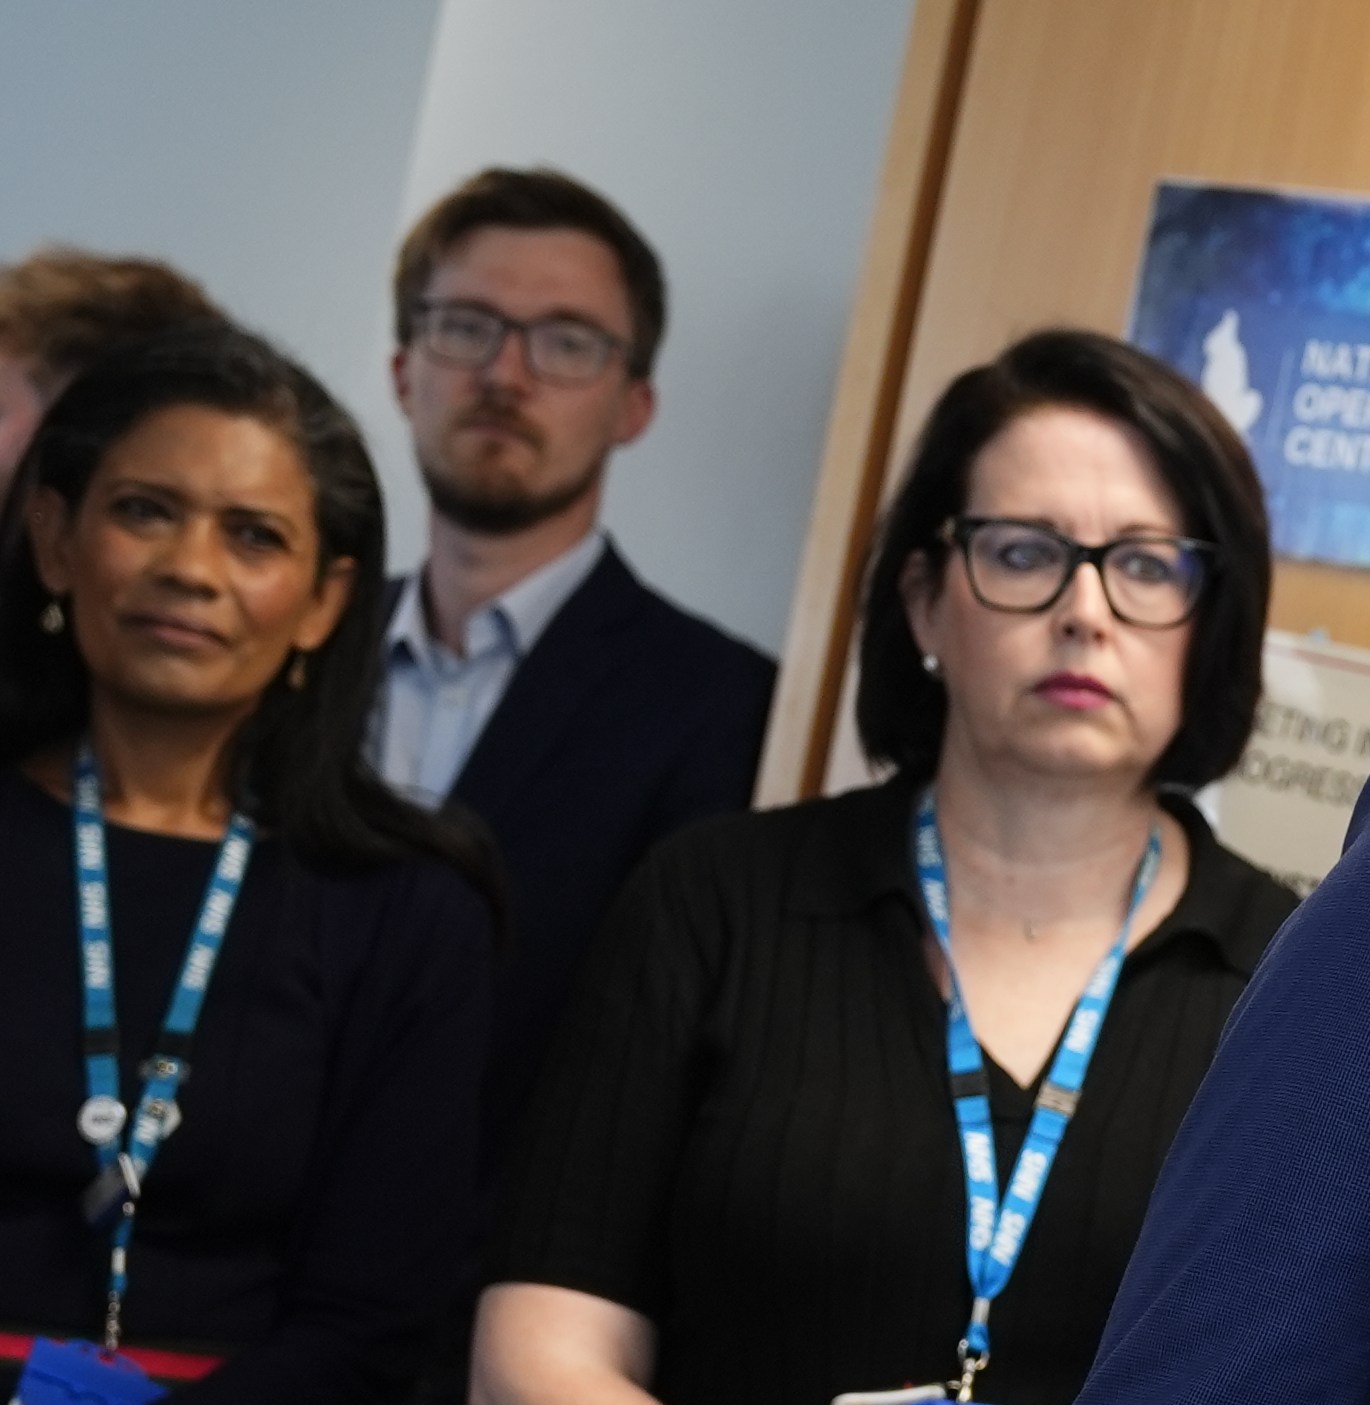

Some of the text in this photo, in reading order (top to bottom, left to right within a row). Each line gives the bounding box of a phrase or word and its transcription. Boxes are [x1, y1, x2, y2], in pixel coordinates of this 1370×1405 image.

[1066, 1008, 1099, 1055] NHS
[963, 1130, 993, 1184] NHS
[1010, 1148, 1047, 1203] NHS
[990, 1209, 1026, 1267] NHS
